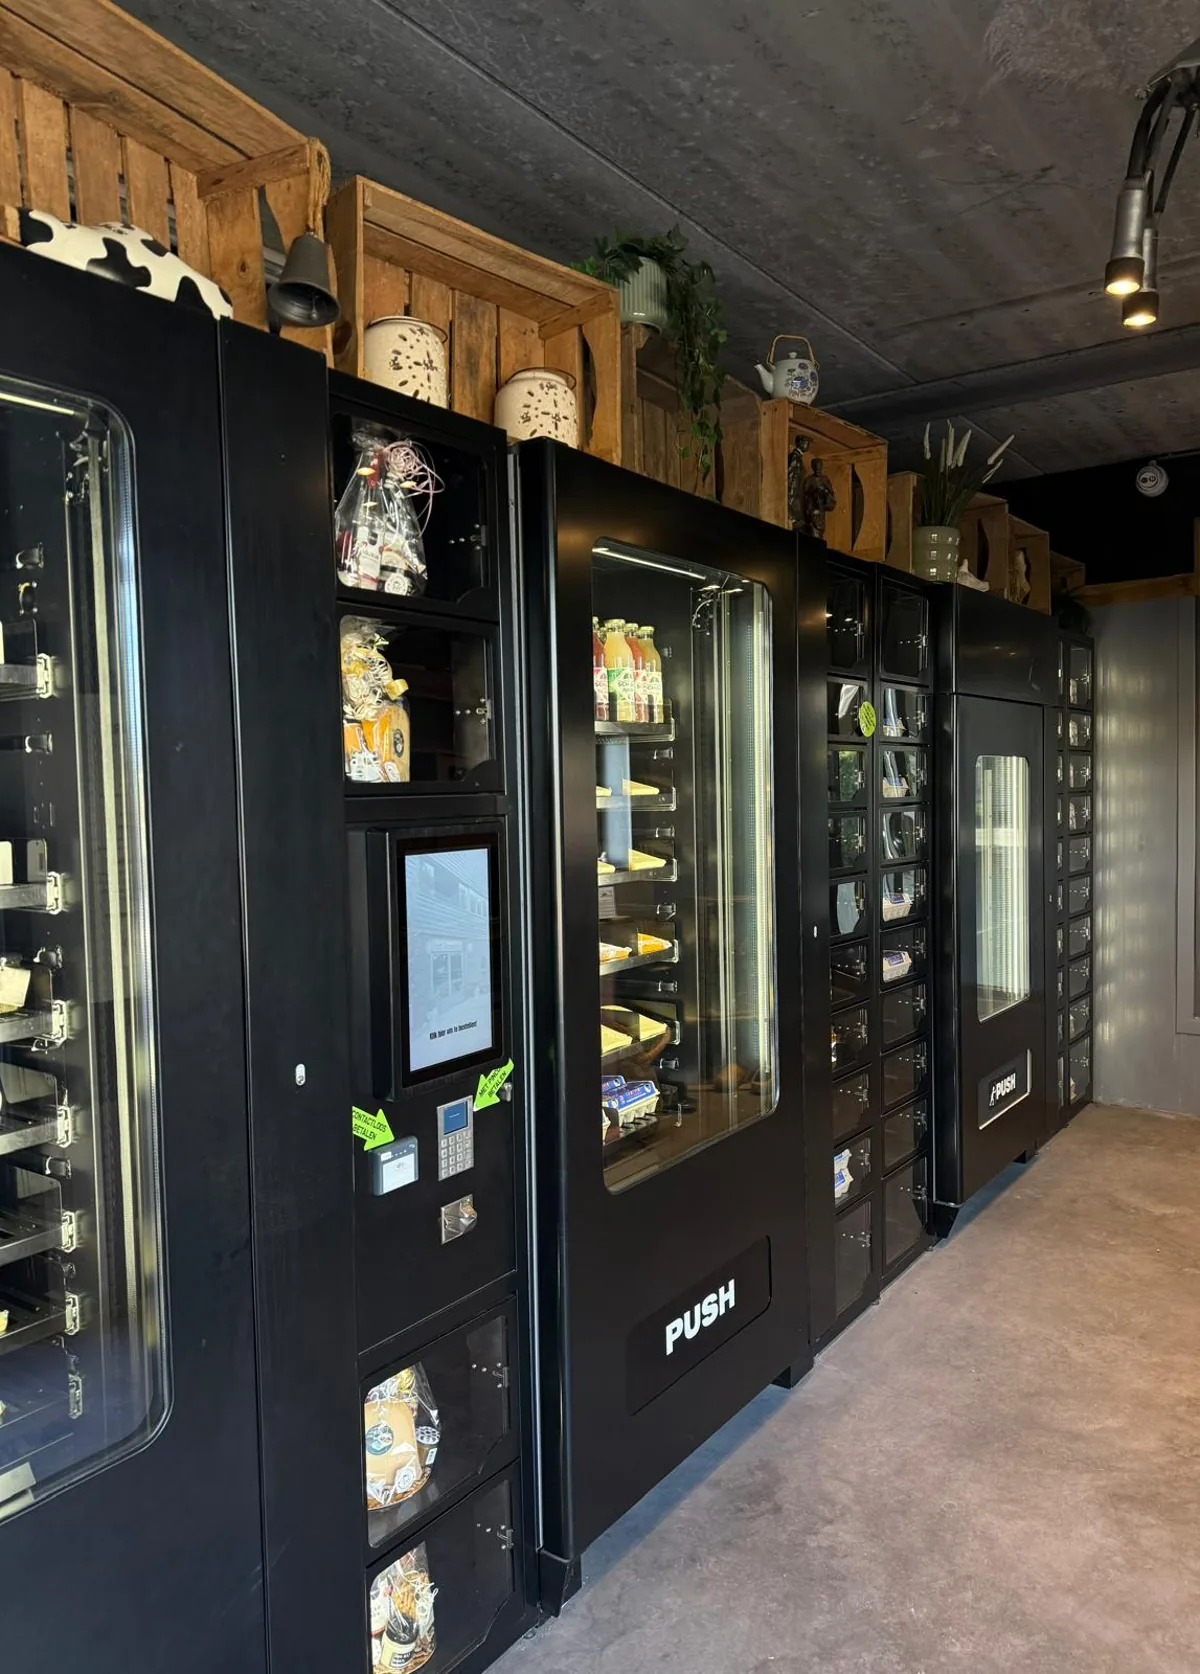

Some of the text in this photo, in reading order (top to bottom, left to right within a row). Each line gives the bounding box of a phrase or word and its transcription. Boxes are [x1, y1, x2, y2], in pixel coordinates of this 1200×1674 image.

[479, 1083, 489, 1097] MET
[488, 1071, 507, 1098] BETALEN
[996, 1073, 1015, 1100] PUSH
[352, 1110, 387, 1133] CONTACTLOOS
[353, 1123, 377, 1141] BETALEN
[665, 1278, 735, 1356] PUSH
